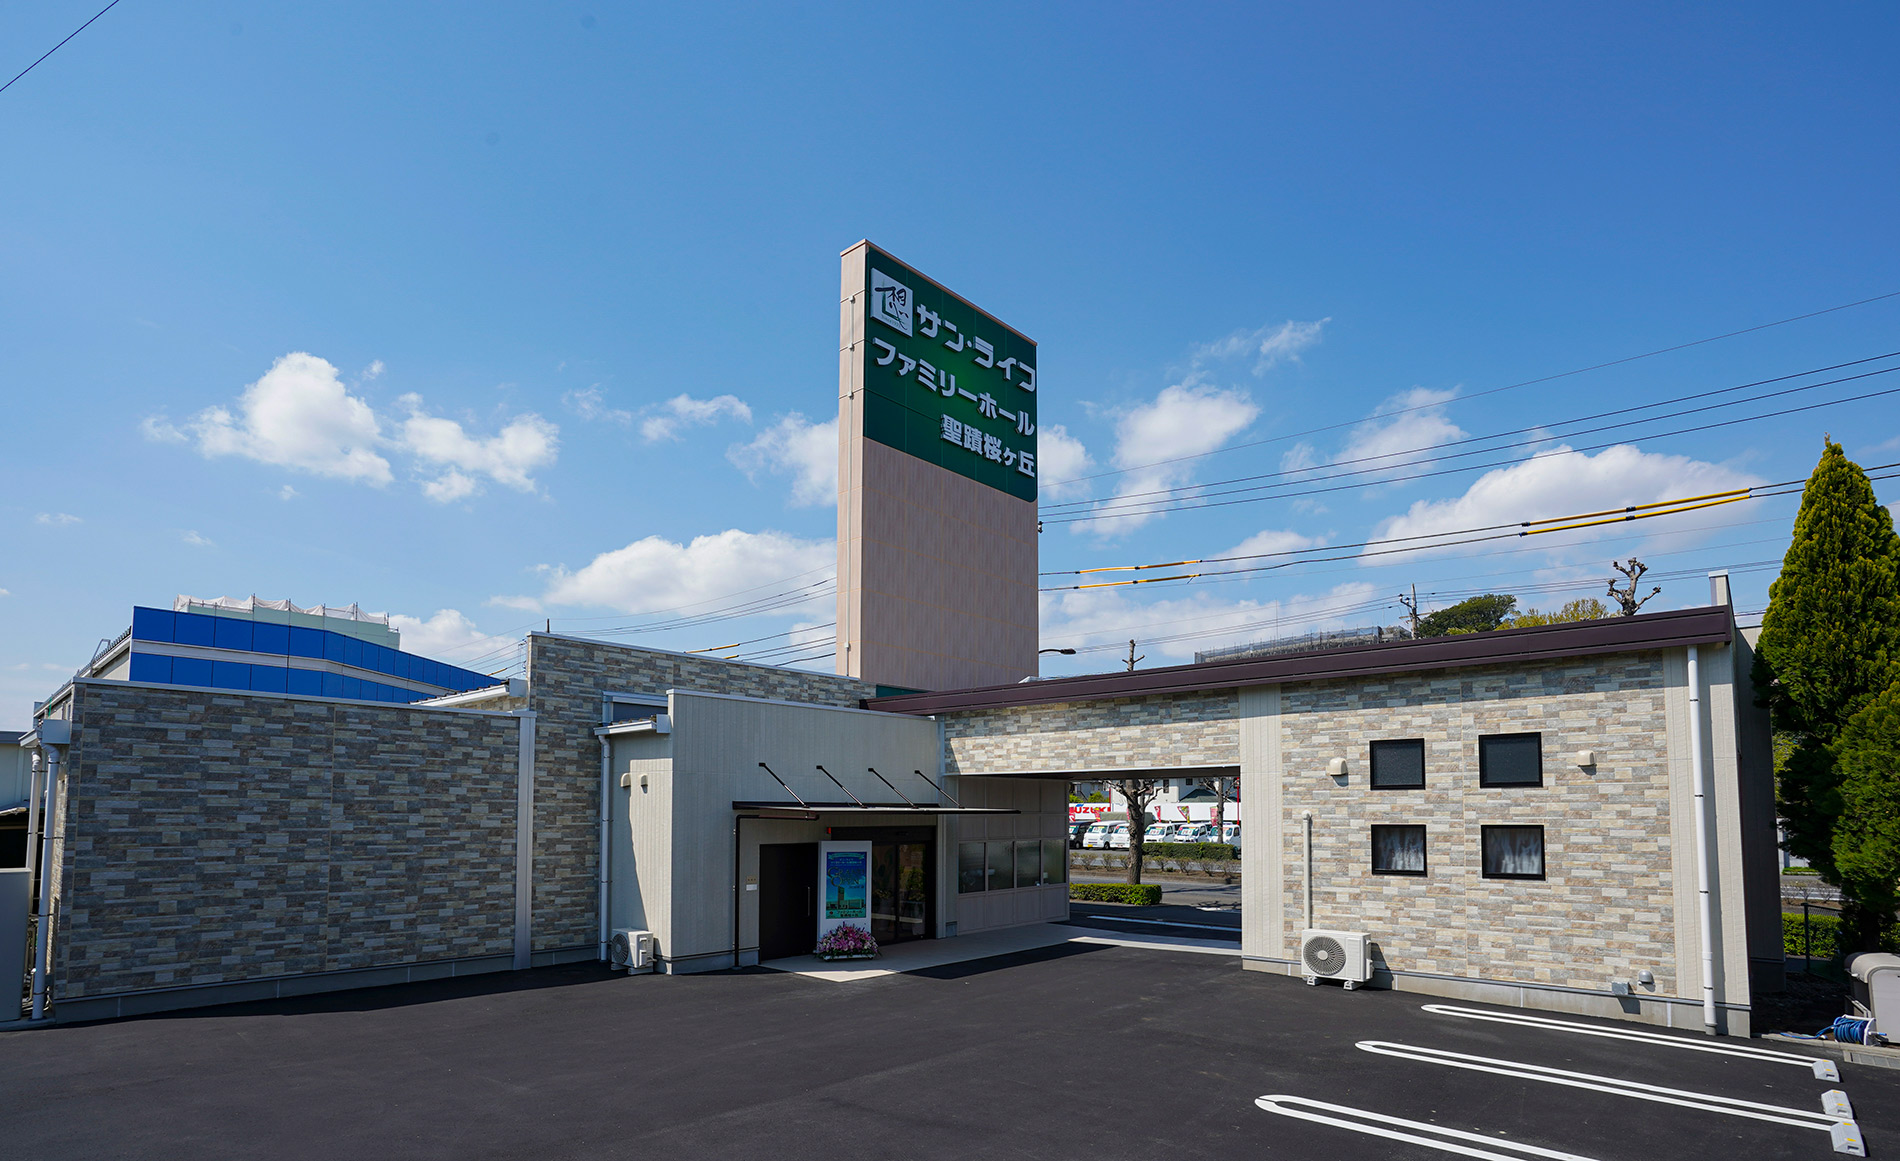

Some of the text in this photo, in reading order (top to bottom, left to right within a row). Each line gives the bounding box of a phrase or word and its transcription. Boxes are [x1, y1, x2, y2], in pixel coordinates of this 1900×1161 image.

[917, 304, 1035, 392] サン・ライフ
[873, 338, 1034, 435] ファミリーホール
[941, 414, 1034, 477] 聖蹟桜ヶ丘
[1070, 806, 1111, 814] UZUKI
